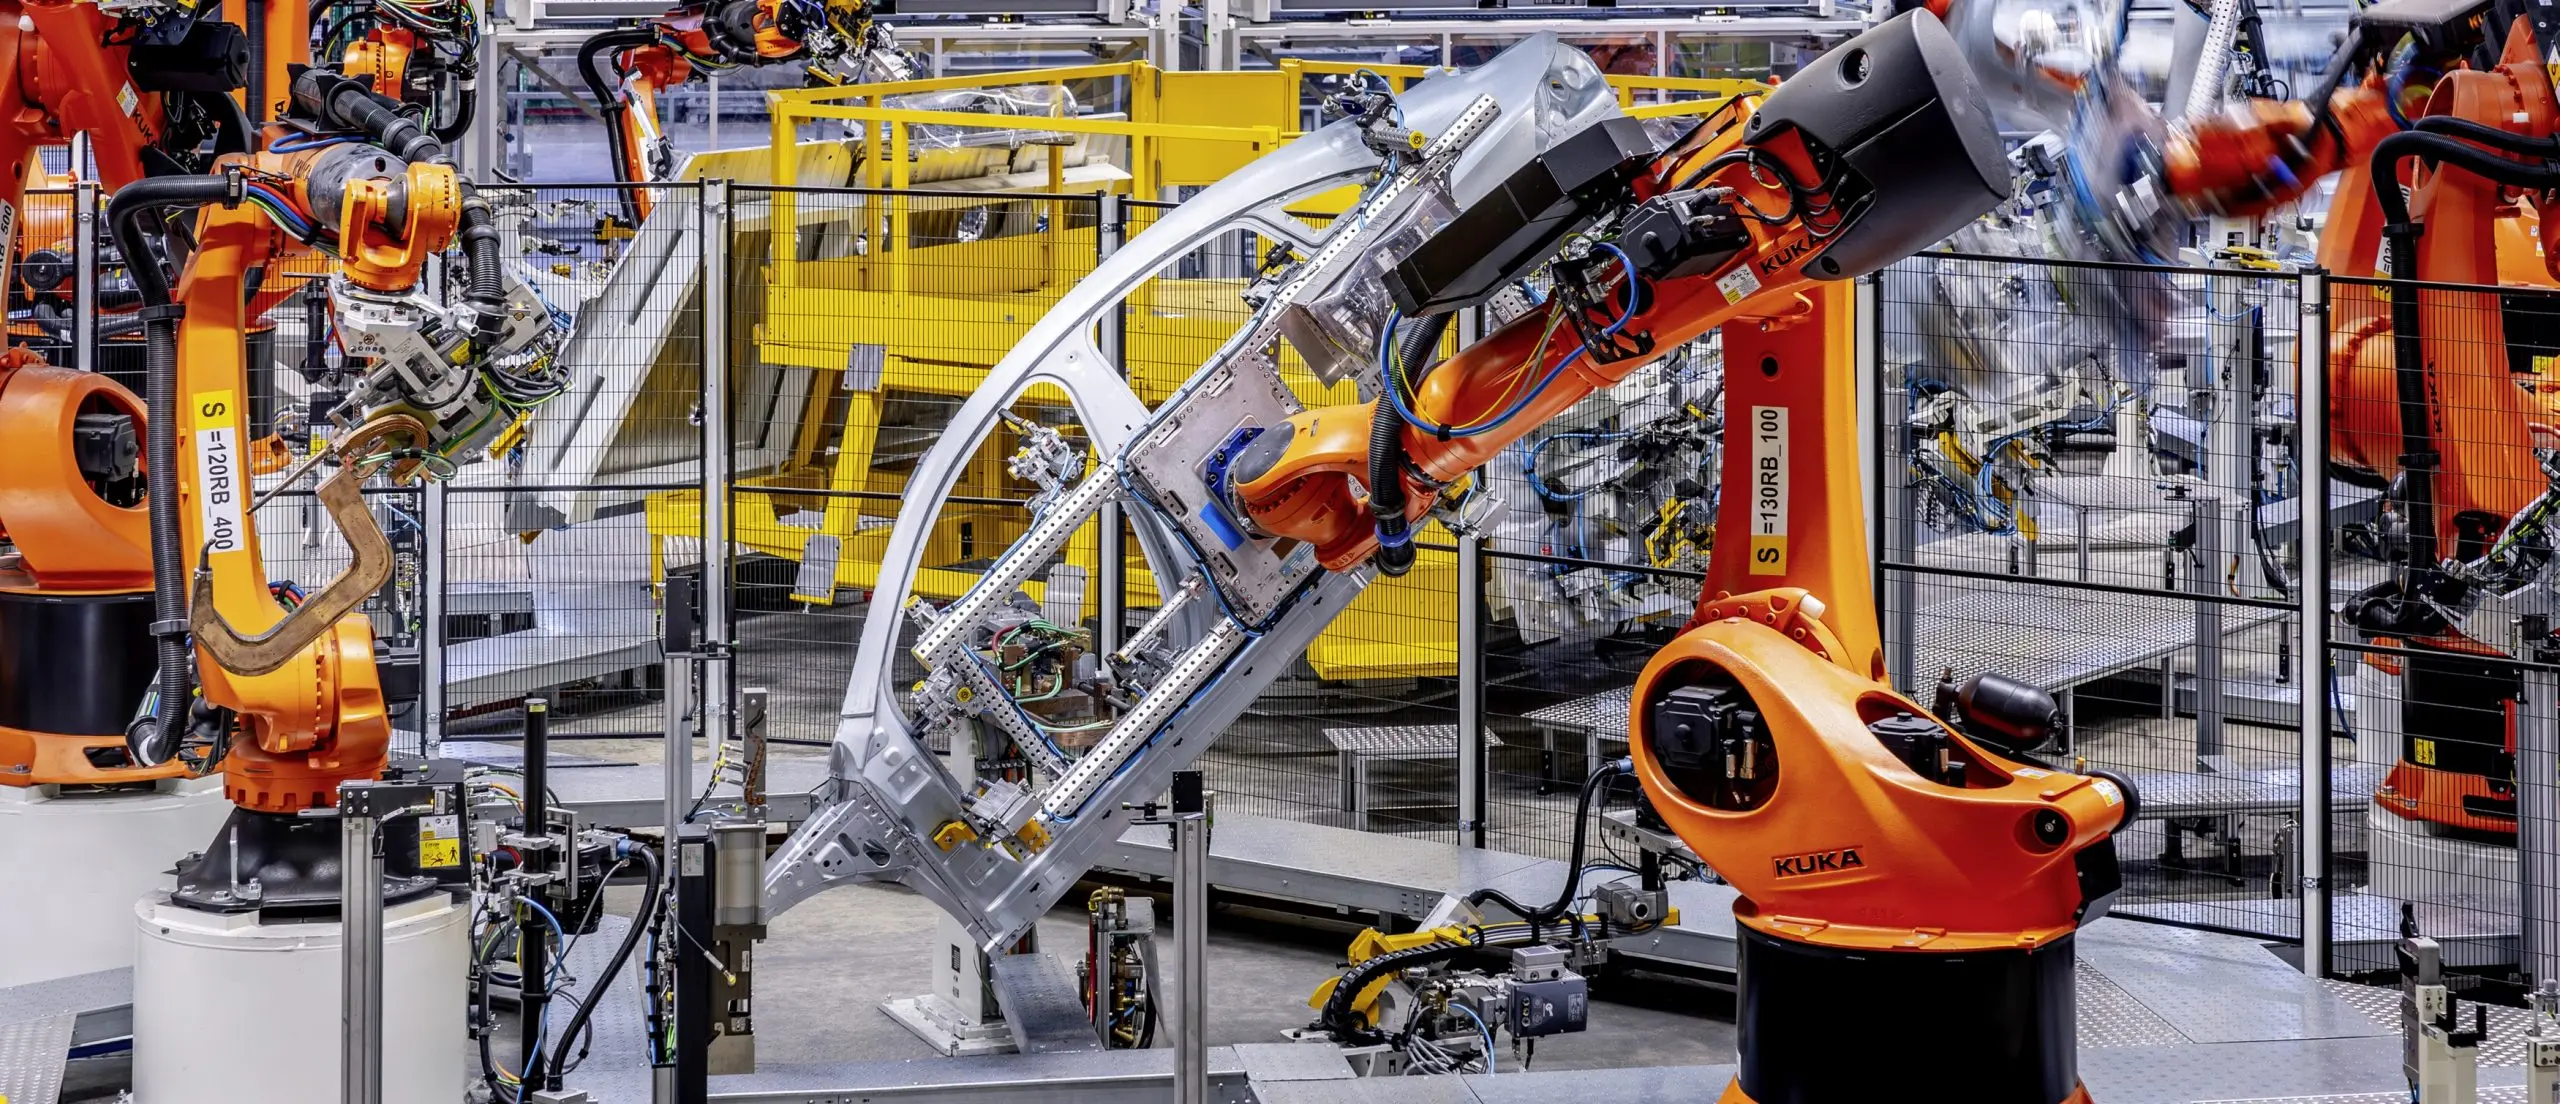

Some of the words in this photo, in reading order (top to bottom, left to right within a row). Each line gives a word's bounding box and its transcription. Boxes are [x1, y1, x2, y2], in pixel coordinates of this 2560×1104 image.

[202, 402, 226, 418] S
[1760, 409, 1782, 534] =130RB_100
[207, 430, 234, 550] =120RB_400
[1757, 547, 1780, 564] S
[1775, 849, 1864, 877] KUKA
